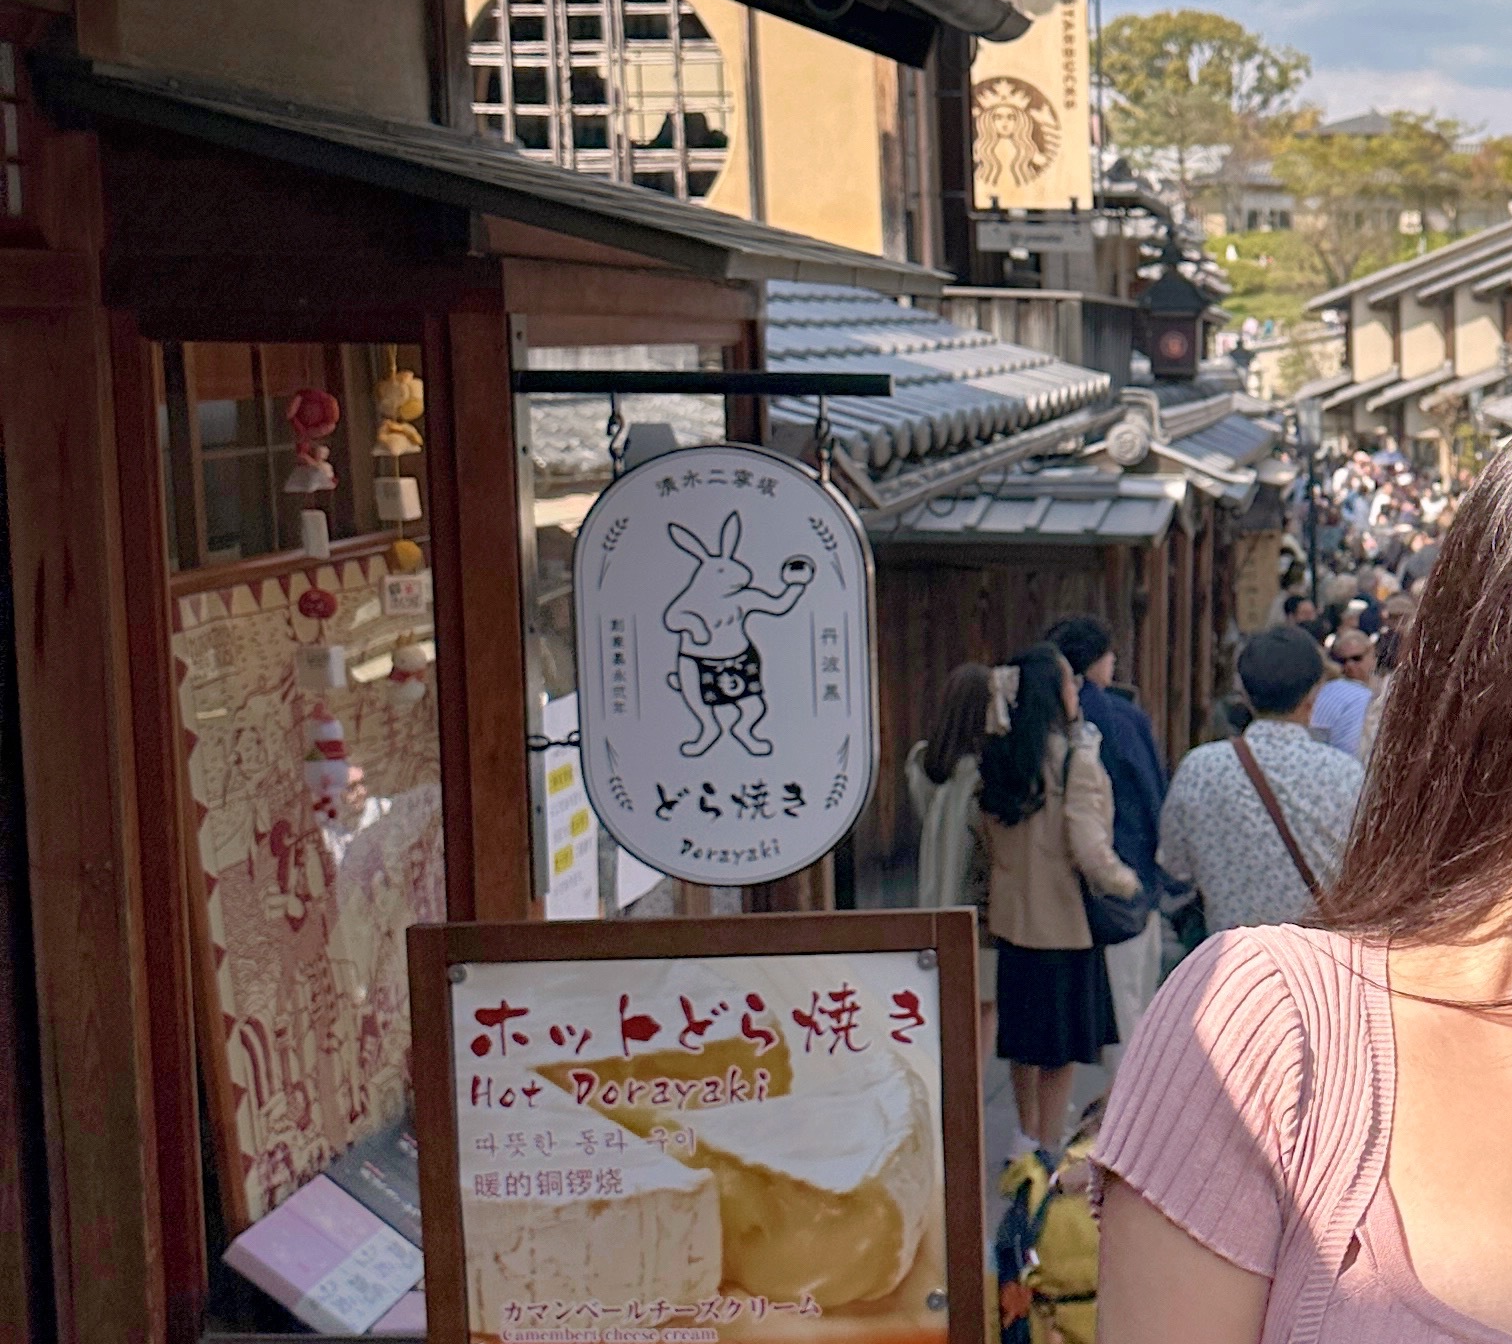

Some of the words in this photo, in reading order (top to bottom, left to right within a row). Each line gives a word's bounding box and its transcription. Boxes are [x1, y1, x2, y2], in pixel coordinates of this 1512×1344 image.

[655, 777, 807, 823] どら焼き
[680, 837, 781, 866] Dorayaki
[470, 982, 926, 1058] ホットどら焼き
[471, 1074, 542, 1108] Hot
[572, 1066, 768, 1111] Dorayaki
[475, 1129, 558, 1158] 따뜻한
[646, 1126, 696, 1156] 구이
[504, 1295, 823, 1322] カマンベールチーズクリーム
[605, 1327, 659, 1342] cheese
[662, 1329, 717, 1342] cream
